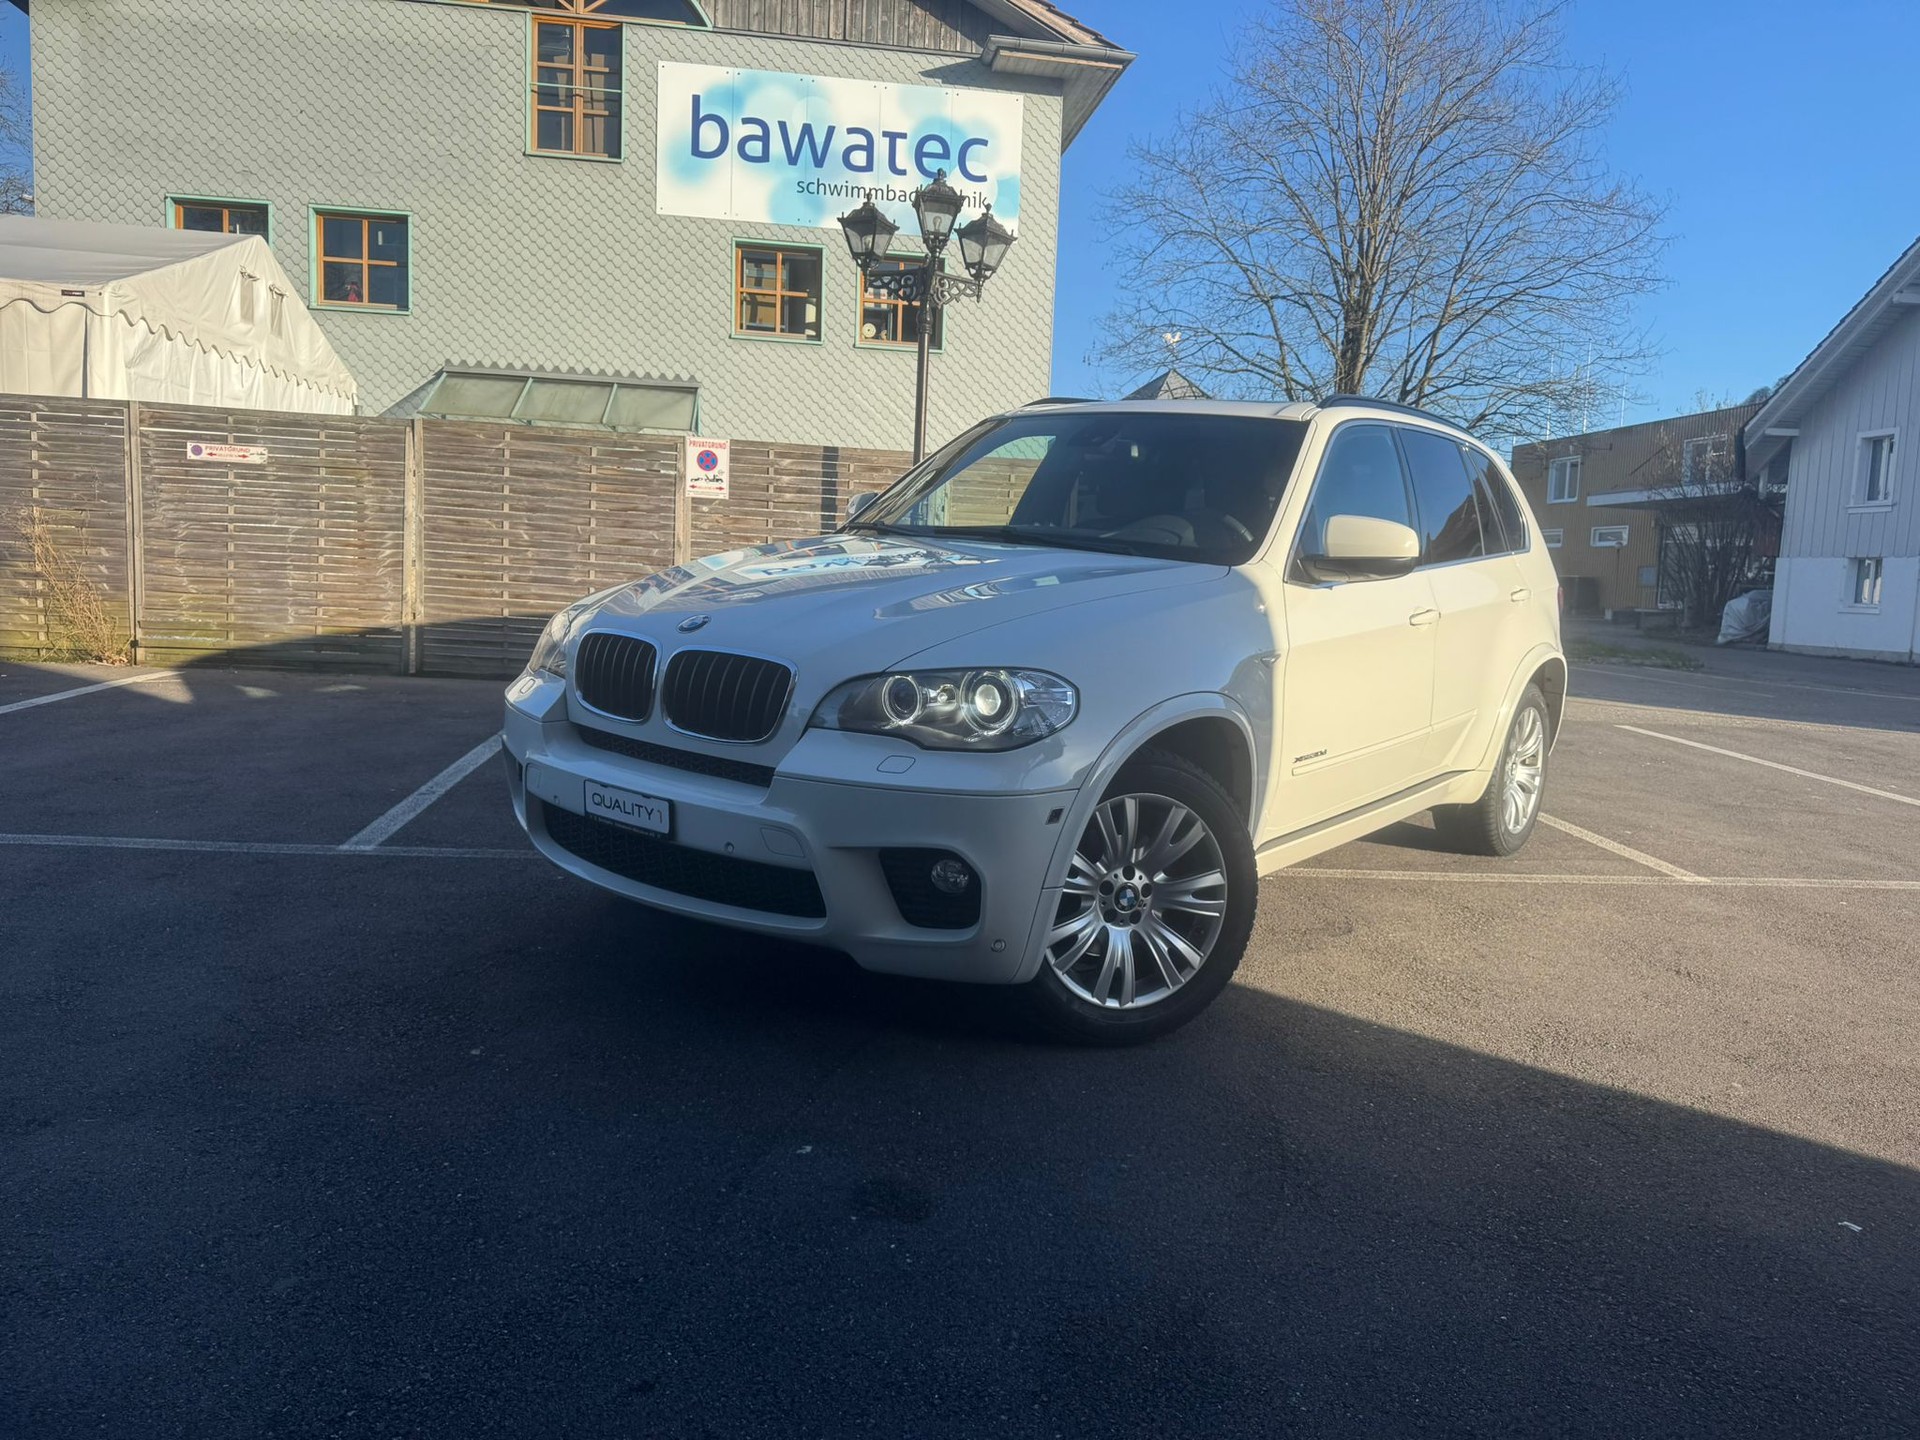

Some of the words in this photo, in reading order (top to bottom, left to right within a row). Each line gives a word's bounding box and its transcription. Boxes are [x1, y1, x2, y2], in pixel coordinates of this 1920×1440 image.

[690, 94, 989, 183] bawatec
[591, 792, 654, 821] QUALITY
[657, 809, 663, 824] 1
